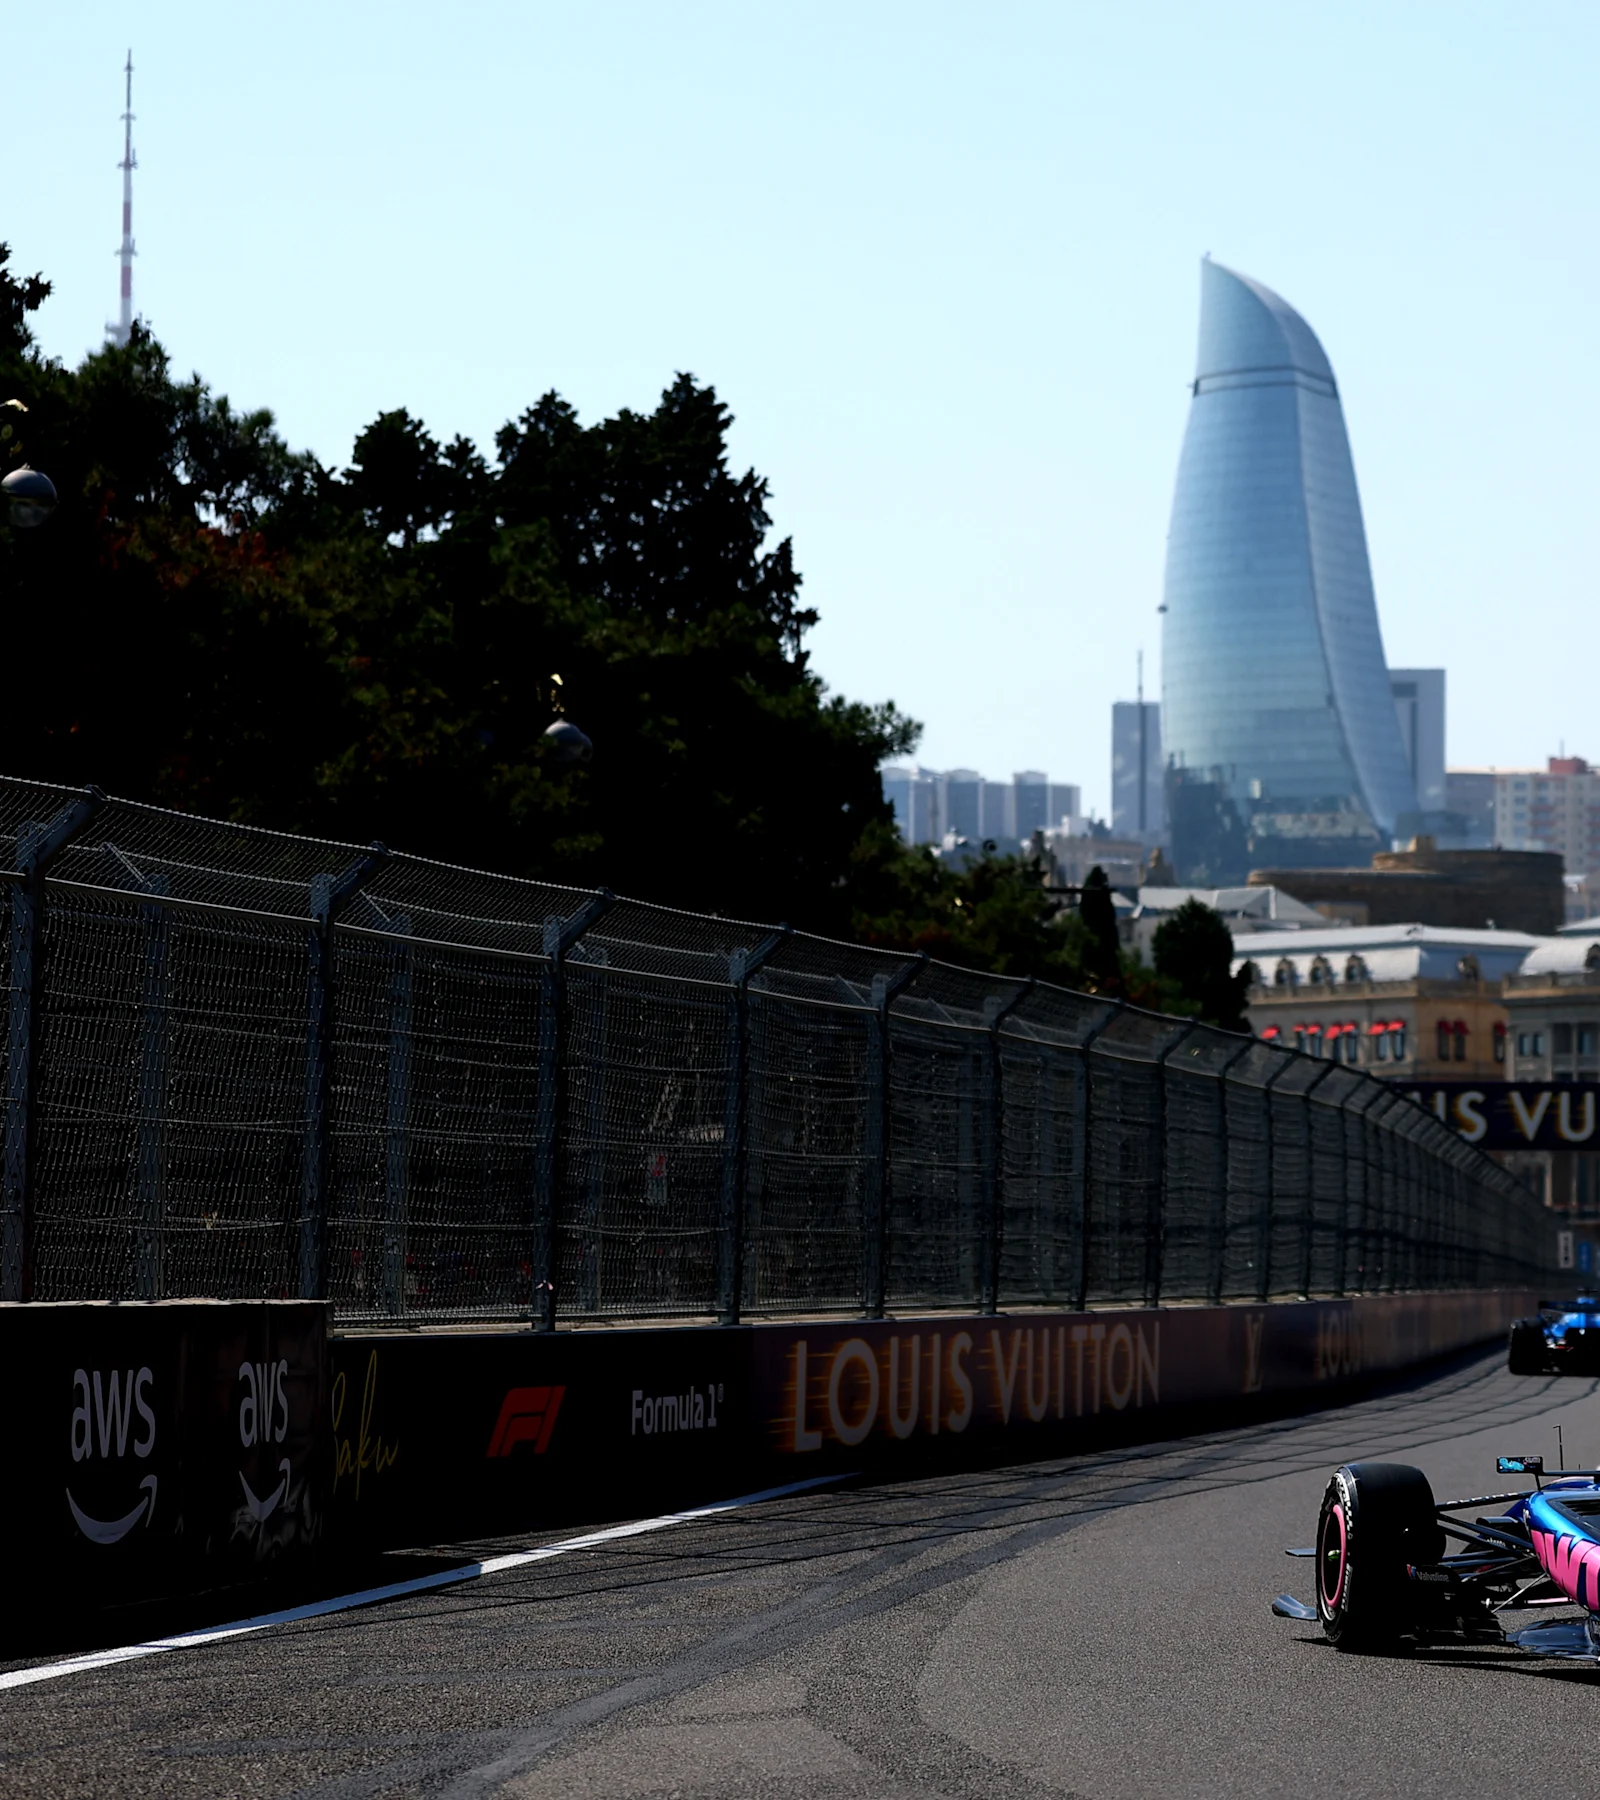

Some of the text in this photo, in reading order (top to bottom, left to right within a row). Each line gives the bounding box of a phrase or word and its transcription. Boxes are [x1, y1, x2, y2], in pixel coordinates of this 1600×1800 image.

[71, 1366, 157, 1463] aws
[238, 1358, 289, 1448] aws
[631, 1385, 705, 1437] Formula
[790, 1320, 1161, 1454] LOUIS VUITTON
[1416, 1570, 1450, 1583] Valvoline
